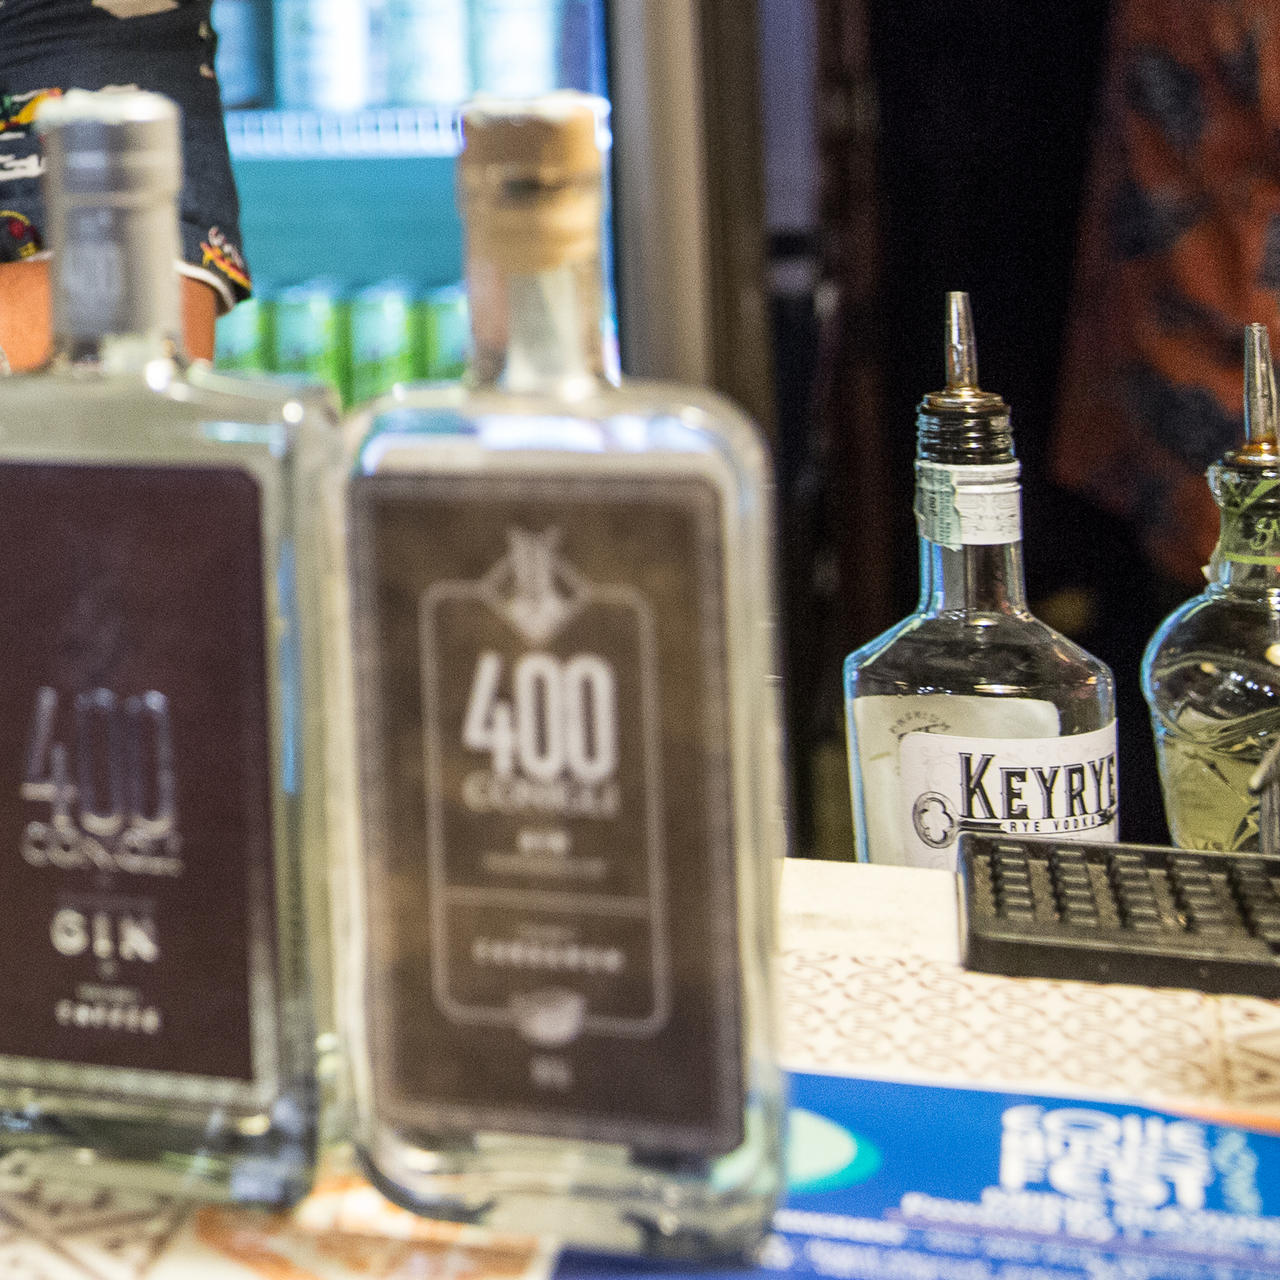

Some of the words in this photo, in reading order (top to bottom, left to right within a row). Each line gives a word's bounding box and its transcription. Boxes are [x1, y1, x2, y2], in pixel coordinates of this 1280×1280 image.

[20, 686, 177, 837] 400
[462, 651, 617, 782] 400
[1009, 821, 1040, 832] RYE
[50, 908, 158, 963] GIN
